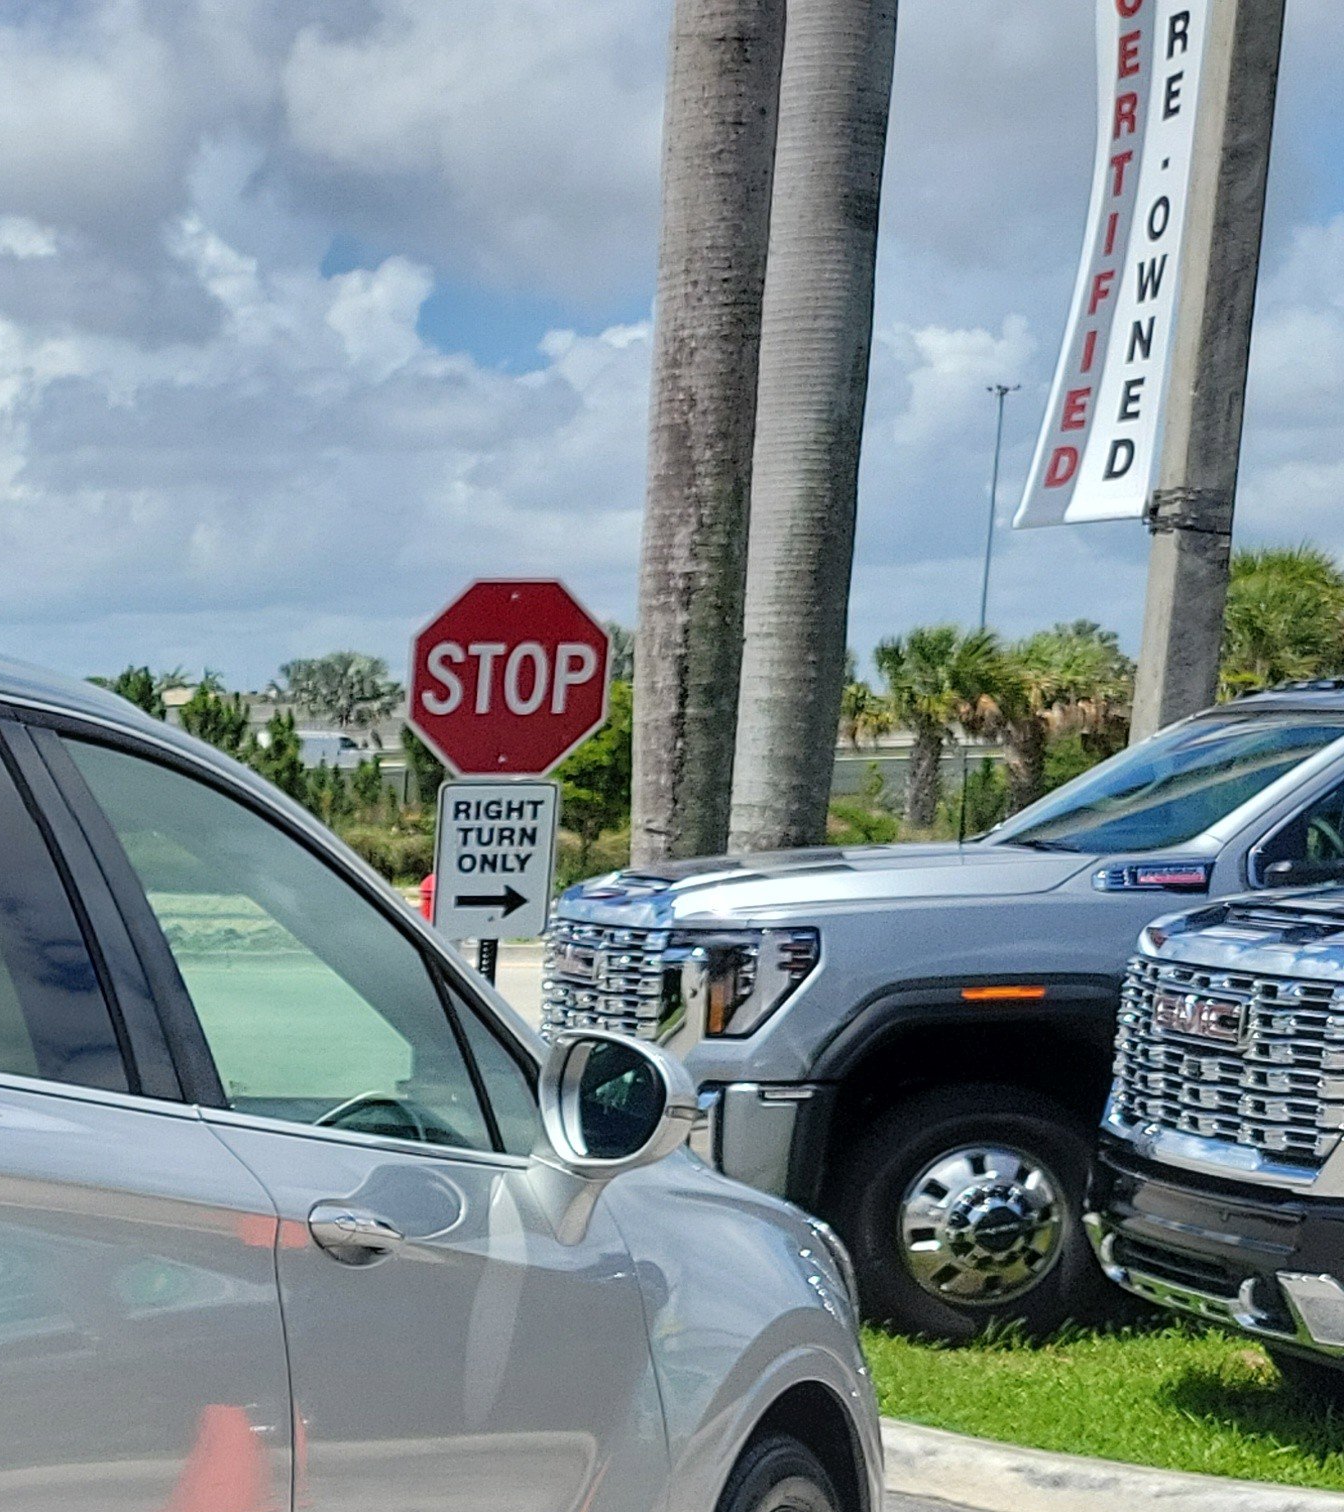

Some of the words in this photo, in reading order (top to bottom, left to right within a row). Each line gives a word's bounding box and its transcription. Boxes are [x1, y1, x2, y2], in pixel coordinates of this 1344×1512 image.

[421, 640, 598, 716] STOP
[452, 799, 545, 822] RIGHT
[456, 826, 538, 847] TURN
[456, 853, 532, 874] ONLY
